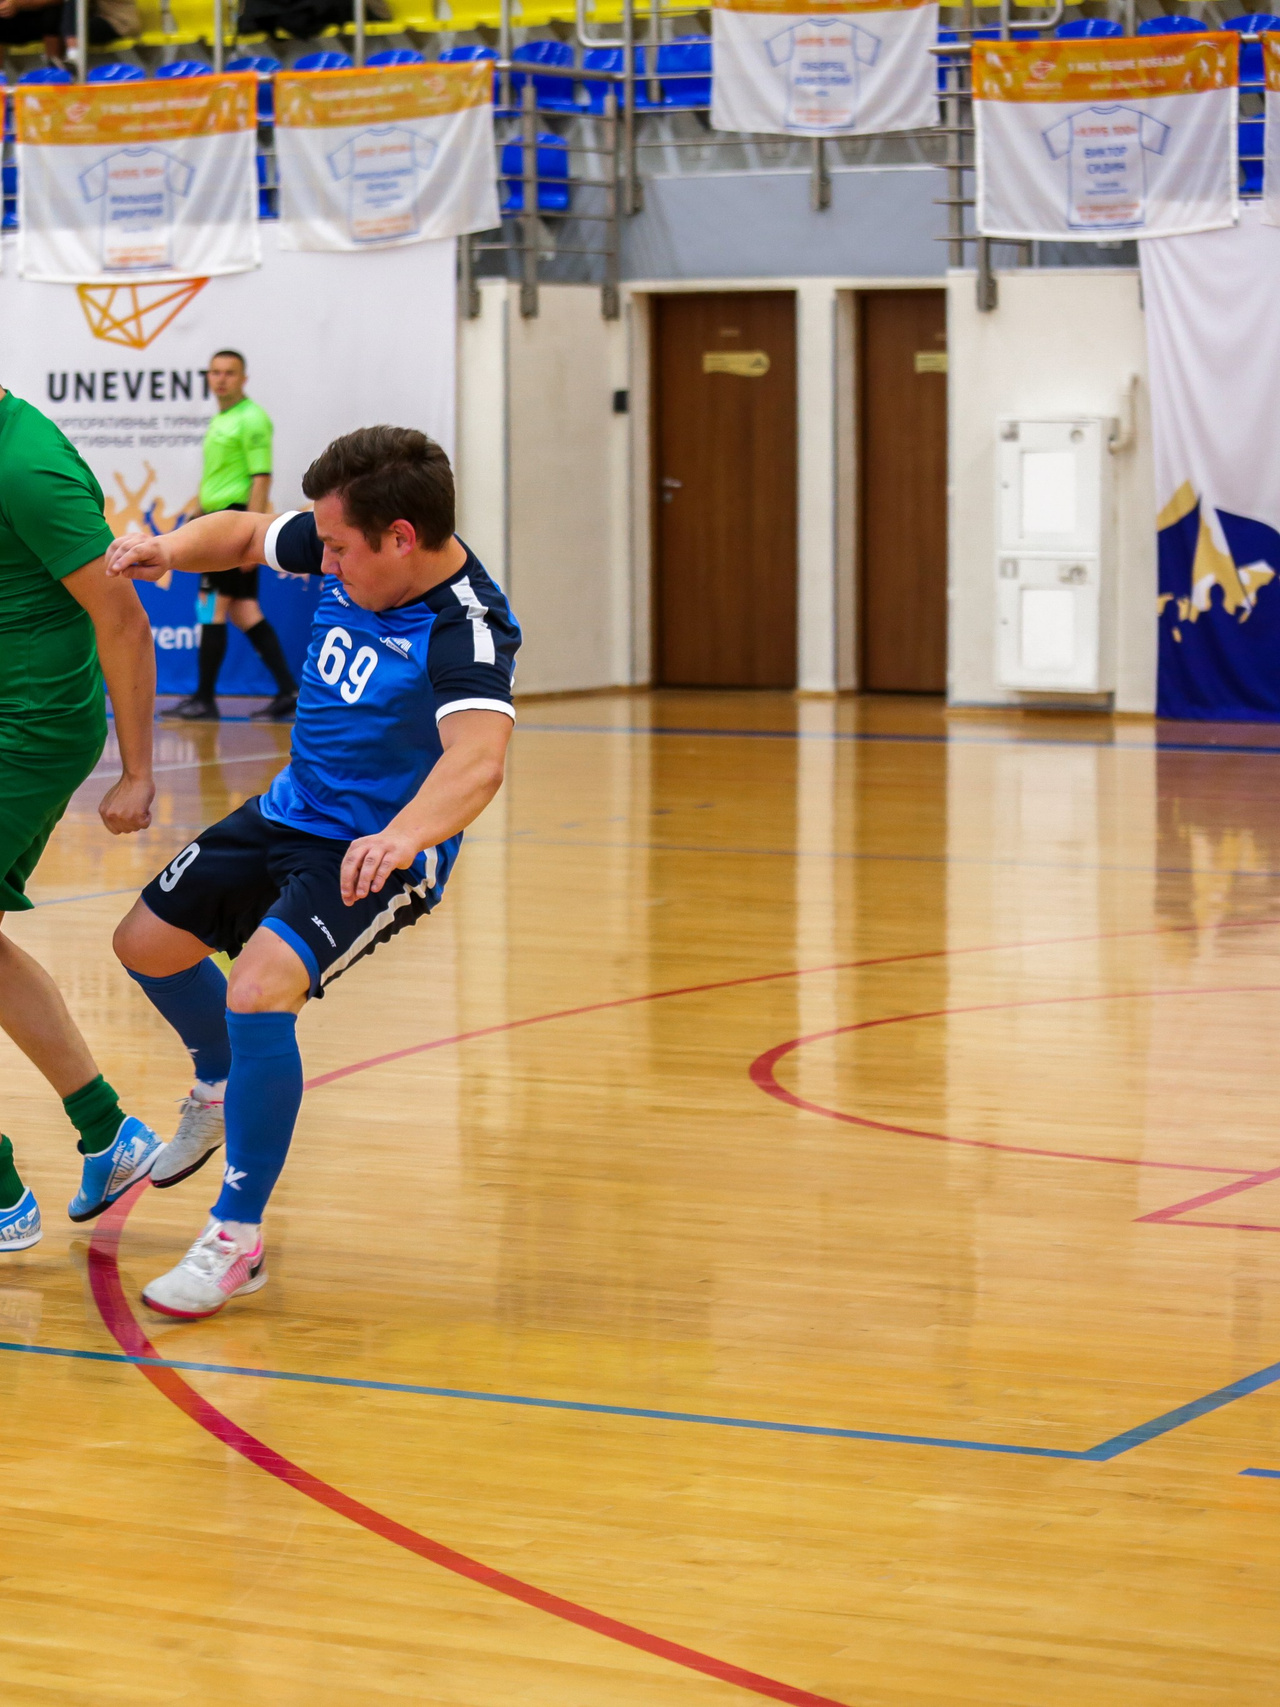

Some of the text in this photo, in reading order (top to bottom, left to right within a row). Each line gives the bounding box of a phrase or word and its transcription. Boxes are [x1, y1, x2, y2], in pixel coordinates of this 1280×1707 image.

[317, 626, 379, 705] 69
[159, 842, 201, 893] 9
[320, 925, 337, 948] SPORT
